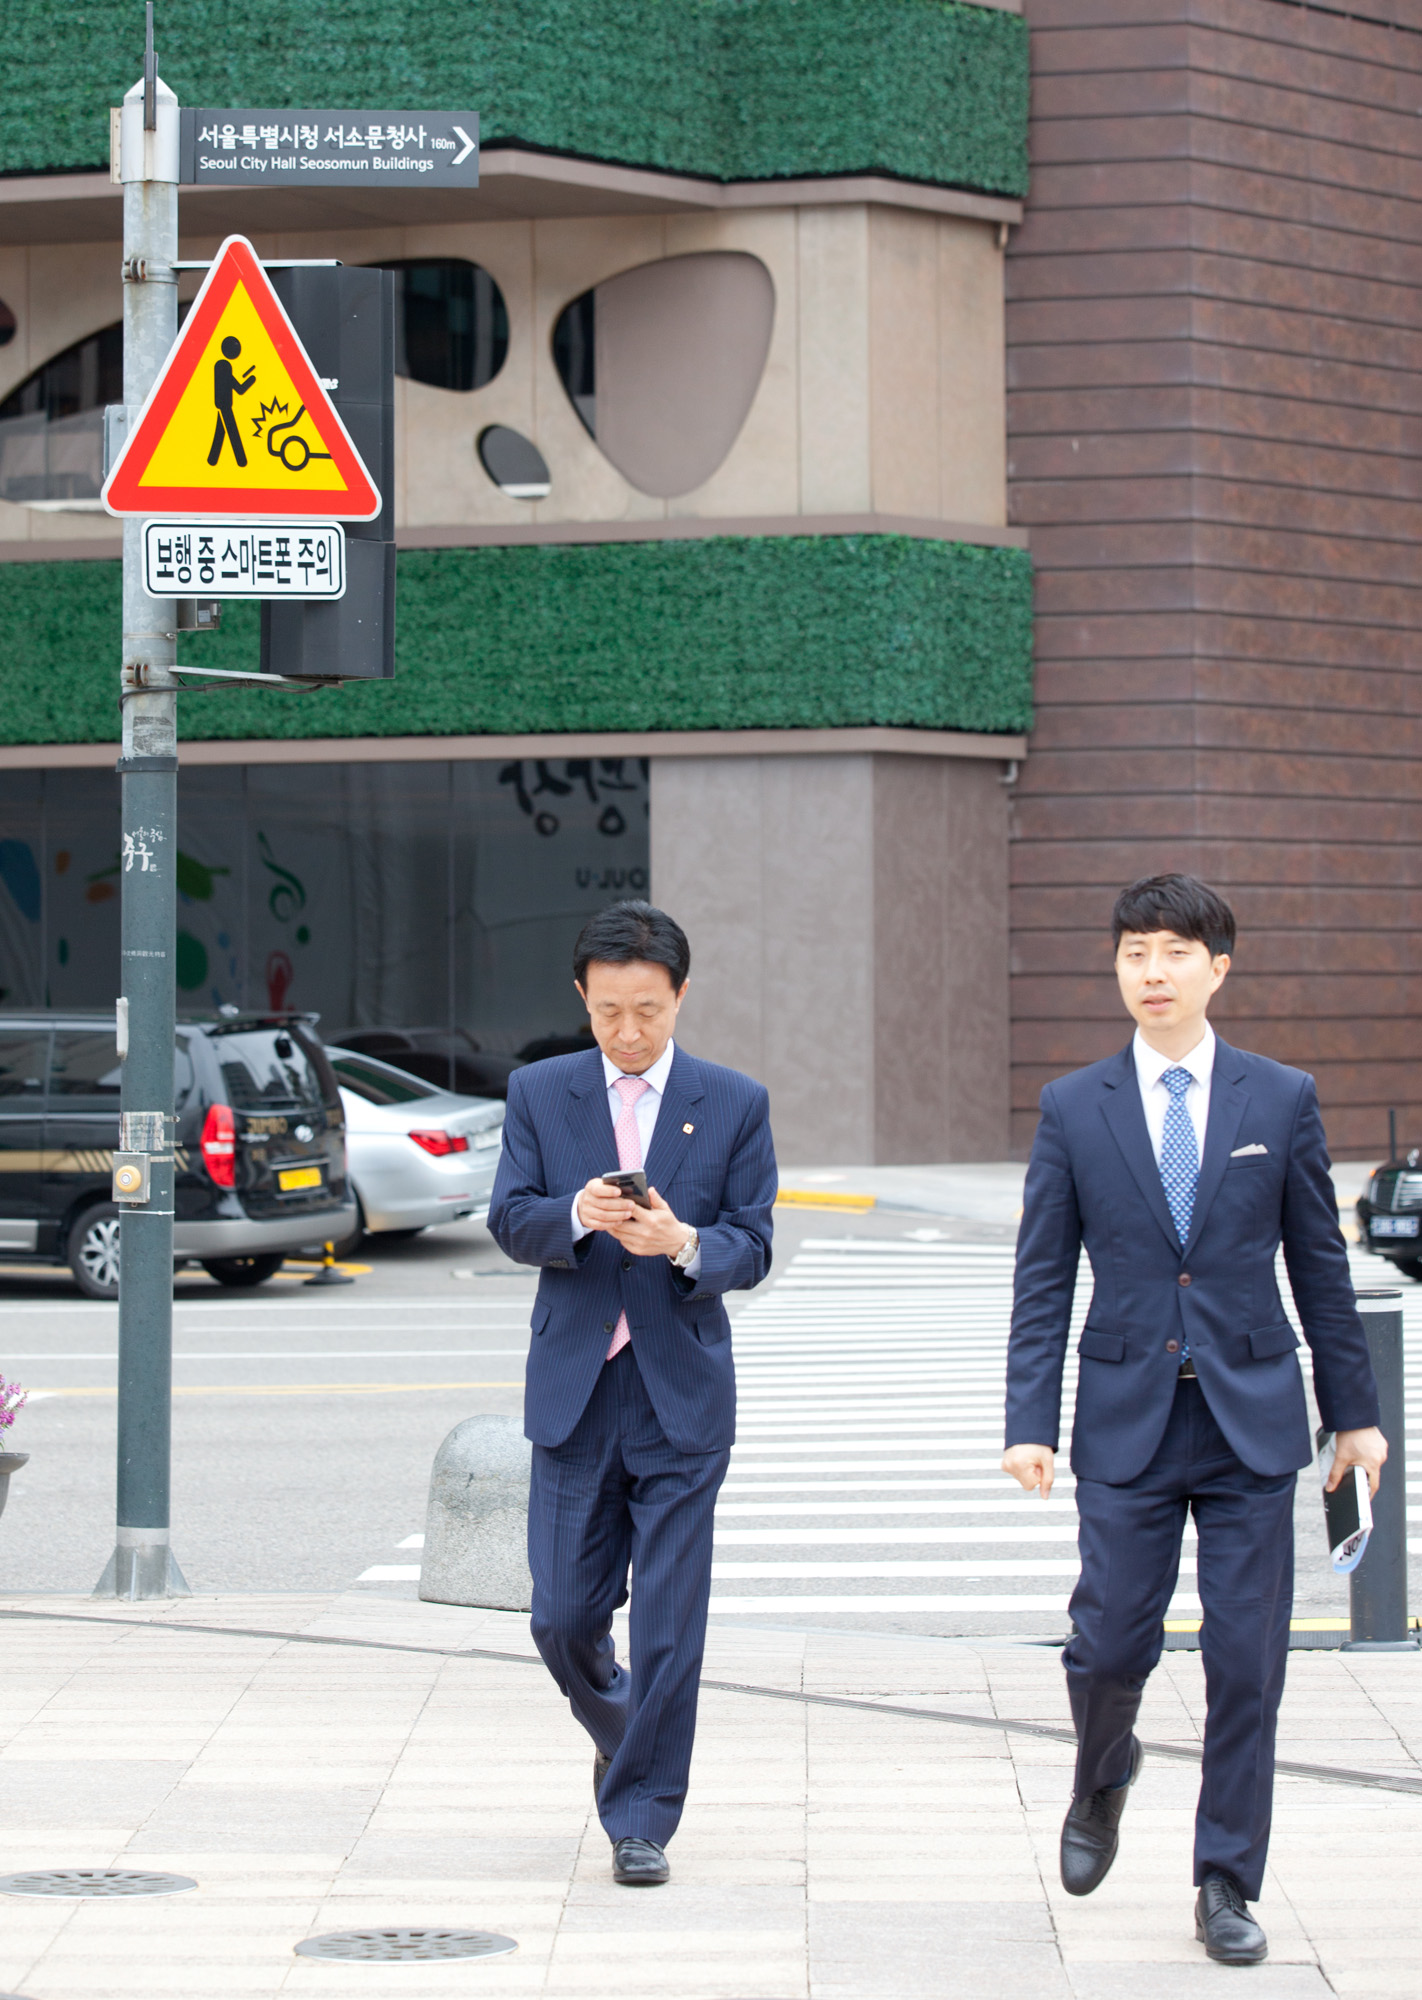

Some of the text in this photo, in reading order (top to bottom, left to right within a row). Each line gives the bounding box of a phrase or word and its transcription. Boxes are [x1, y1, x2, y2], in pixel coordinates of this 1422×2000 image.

[198, 124, 456, 150] 서울특별시청 서소문청사 160m
[199, 156, 435, 173] Seoul City Hall Seosomun Buildings
